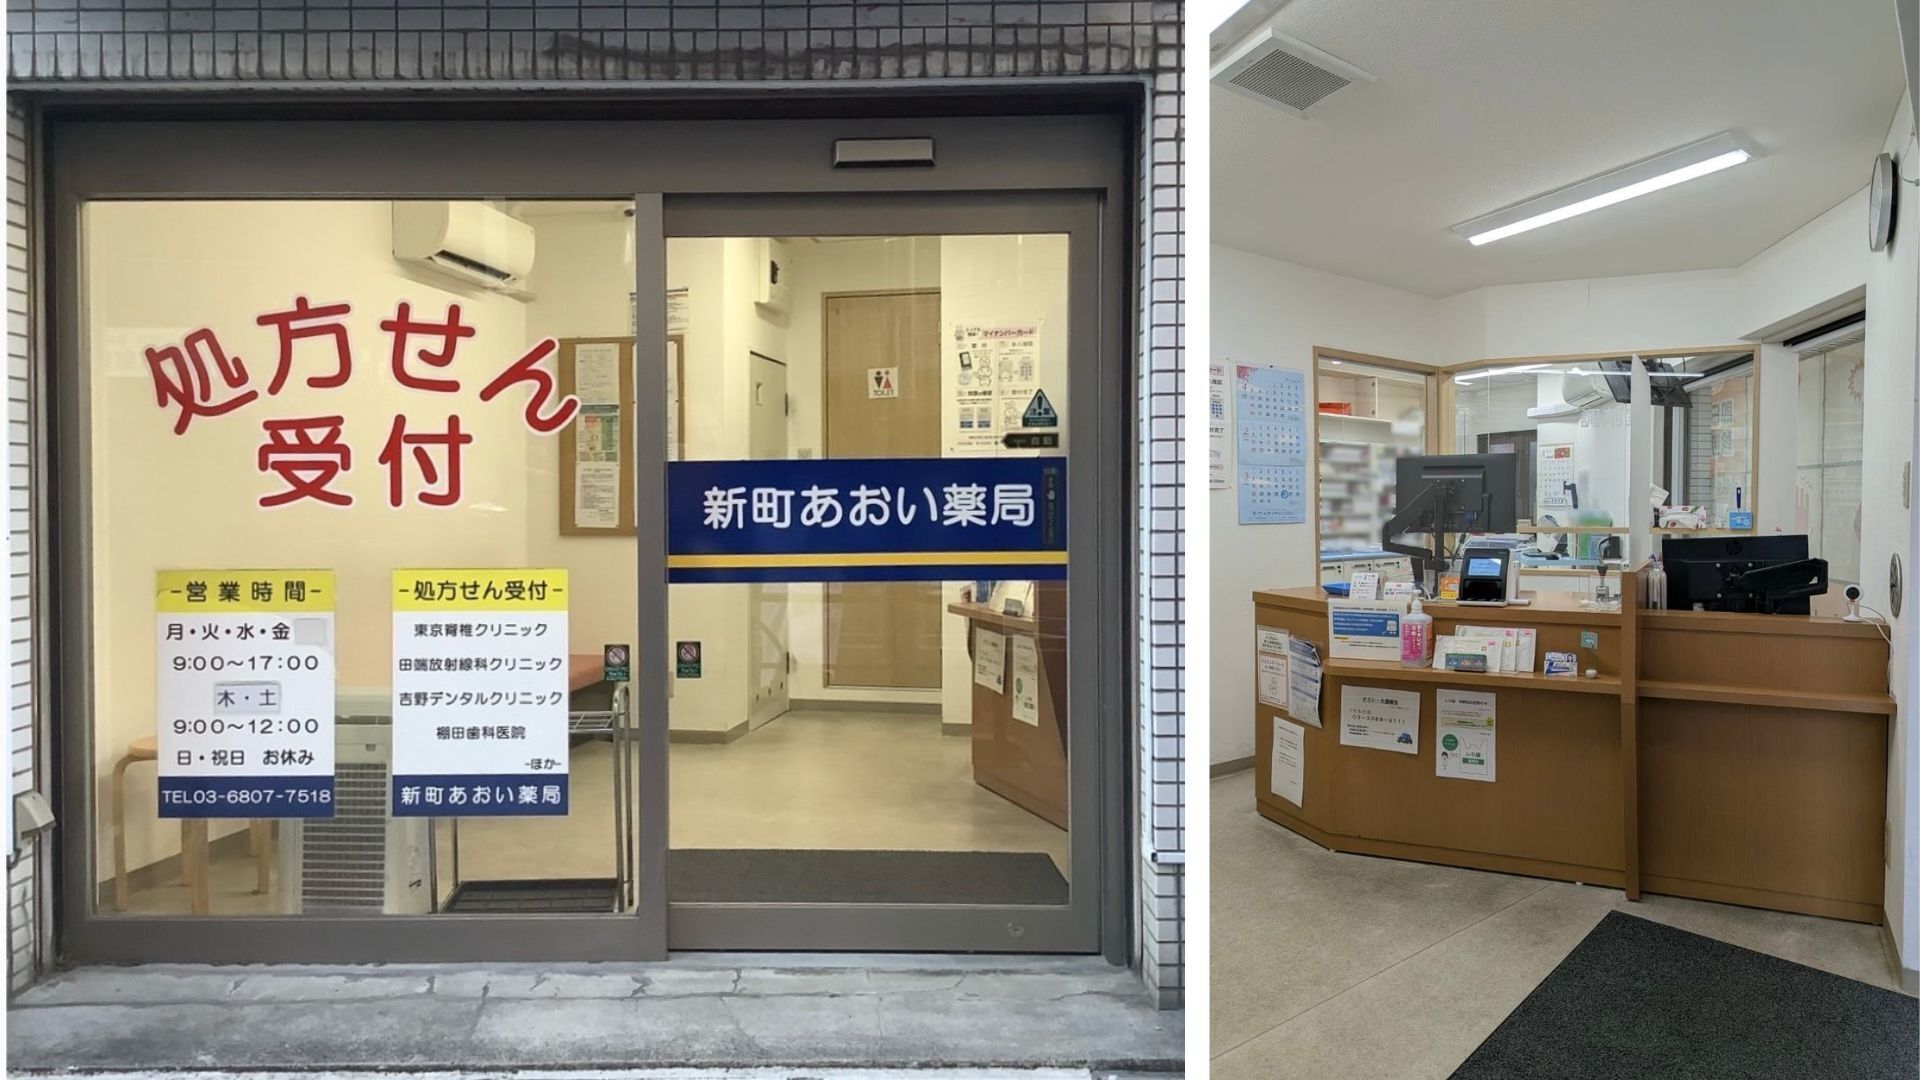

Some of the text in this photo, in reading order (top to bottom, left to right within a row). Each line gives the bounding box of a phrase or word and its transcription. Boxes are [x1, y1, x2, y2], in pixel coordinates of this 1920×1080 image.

[144, 295, 579, 436] 処方せん
[257, 413, 474, 509] 受付
[702, 481, 1036, 530] 新町あおい薬局
[166, 622, 291, 641] 月・火・水・金
[413, 623, 548, 637] 東京脊椎クリニック
[399, 657, 563, 672] 田端放射線科クリニック
[216, 689, 278, 708] 木・土
[399, 691, 563, 706] 吉野デンタルクリニック
[436, 726, 527, 740] 棚田歯科医院
[177, 749, 315, 766] 日・祝日 お休み
[401, 785, 562, 806] 新町あおい薬局
